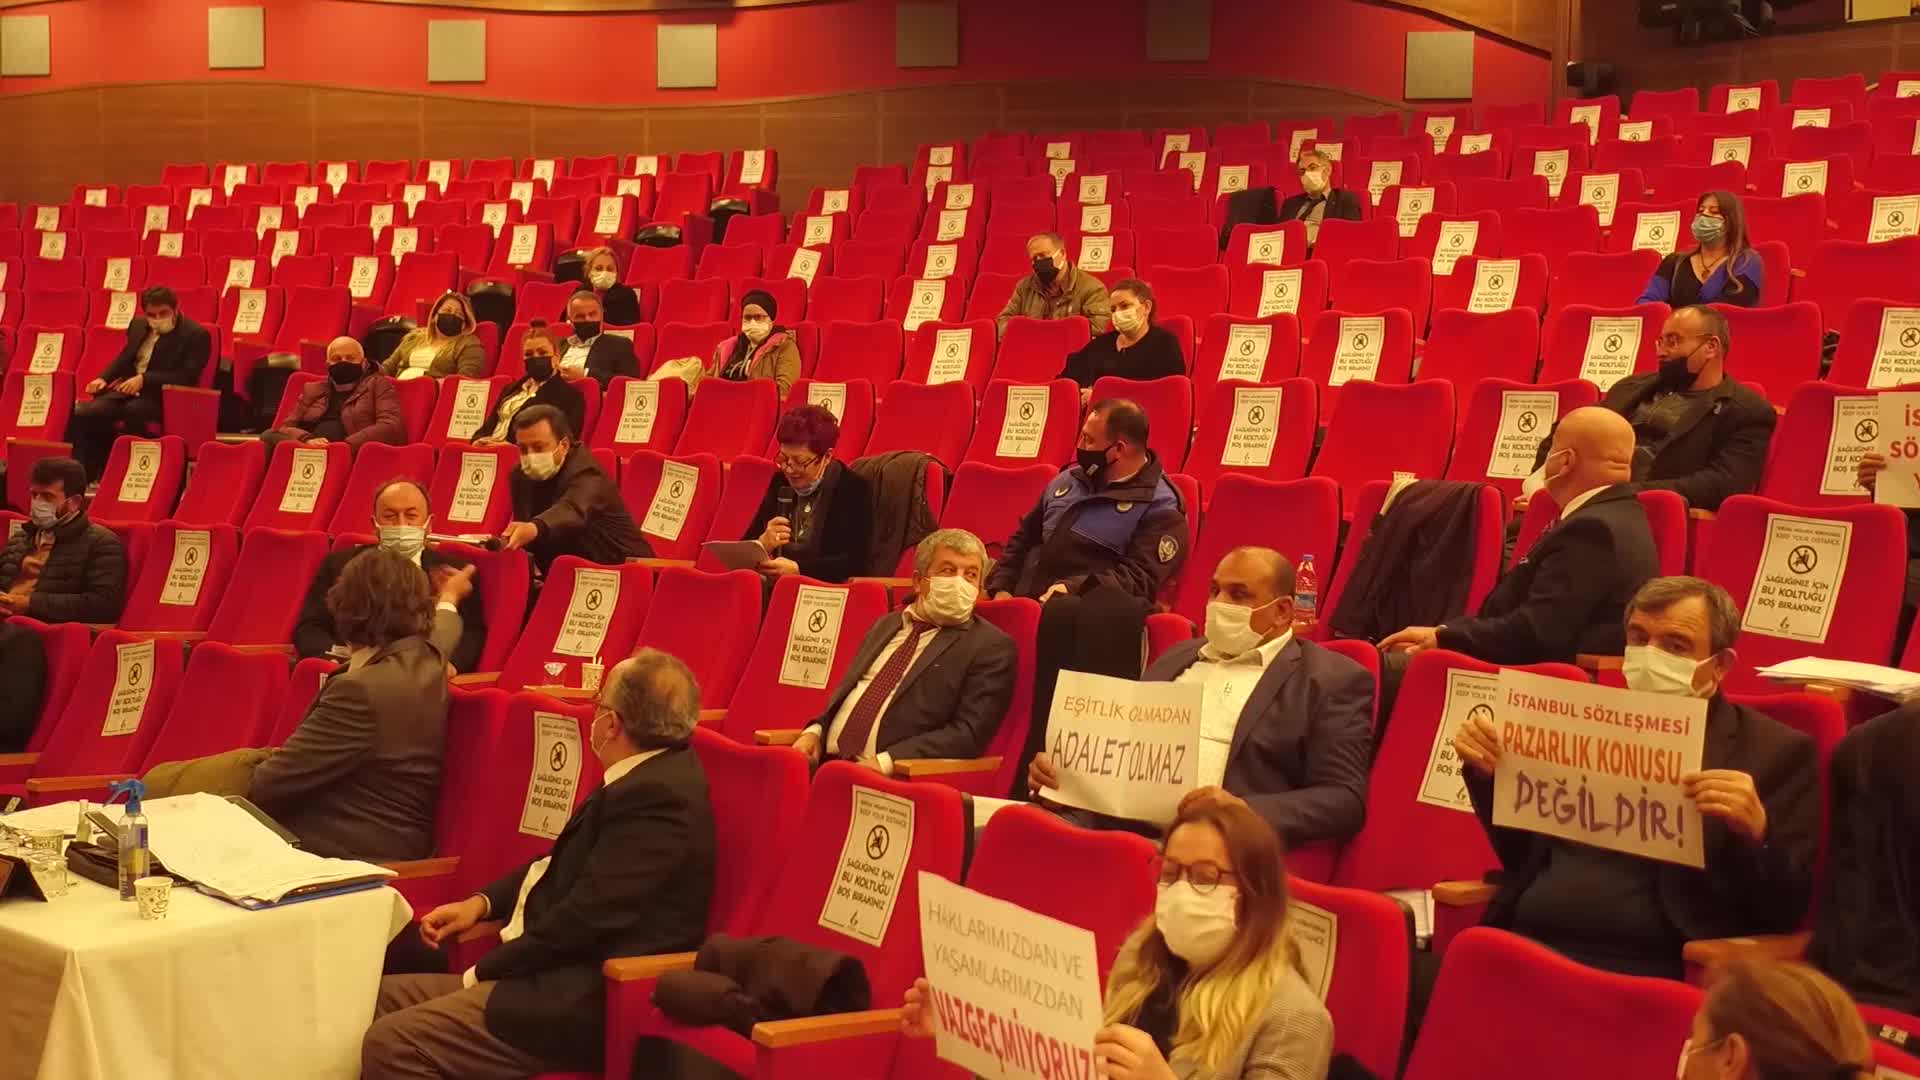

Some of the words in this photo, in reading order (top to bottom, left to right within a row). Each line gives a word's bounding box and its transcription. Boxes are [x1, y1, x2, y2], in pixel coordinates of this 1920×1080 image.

[1765, 575, 1809, 587] SAĞLIĞINIZ
[1812, 580, 1829, 590] İÇİN
[1761, 585, 1776, 594] BU
[1778, 587, 1826, 602] KOLTUĞU
[1758, 597, 1777, 609] BOŞ
[1778, 601, 1822, 614] BIRAKINIZ
[1064, 696, 1125, 721] EŞİTLİK
[1128, 705, 1192, 725] OLMADAN
[1507, 688, 1578, 718] İSTANBUL
[1583, 704, 1690, 736] SÖZLEŞMESİ
[1440, 750, 1454, 761] BU
[1503, 721, 1593, 770] PAZARLIK
[1597, 737, 1682, 785] KONUSU
[1436, 764, 1453, 776] BOŞ
[1514, 770, 1684, 848] DEĞİLDİR!
[836, 886, 852, 901] BOŞ
[840, 870, 854, 883] BU
[854, 875, 890, 896] KOLTUĞU
[928, 900, 1059, 970] HAKLARIMIZDAN
[1063, 954, 1084, 980] VE
